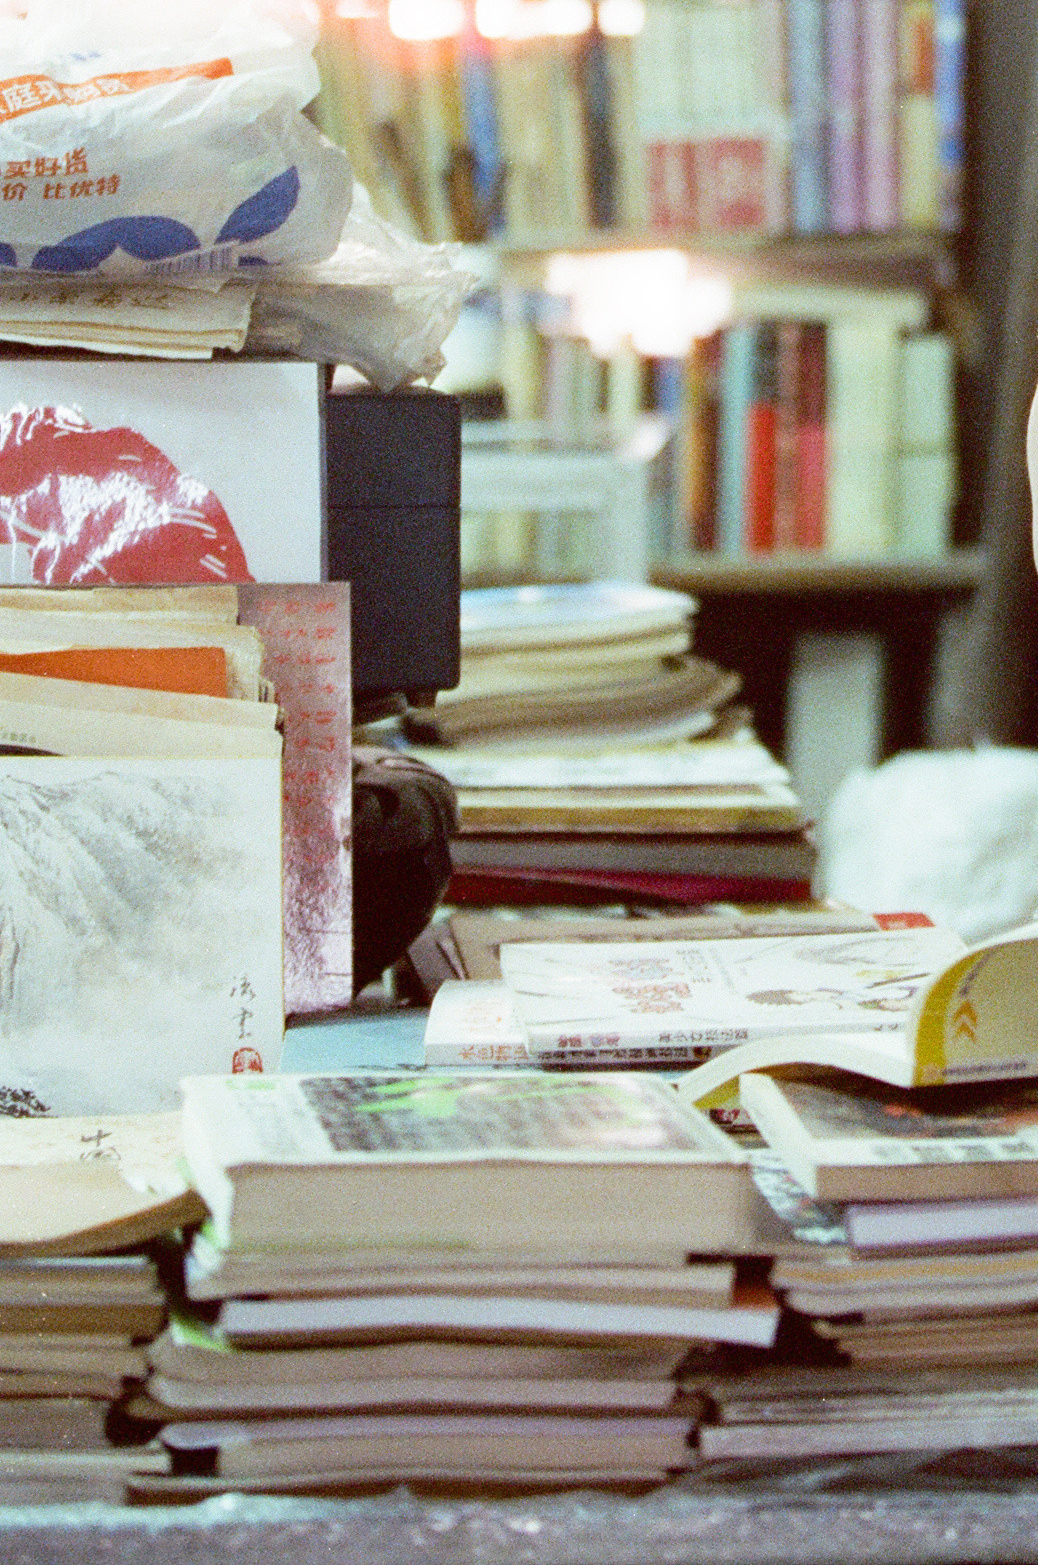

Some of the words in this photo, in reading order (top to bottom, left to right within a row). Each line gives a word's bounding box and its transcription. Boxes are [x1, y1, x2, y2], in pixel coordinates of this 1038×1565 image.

[0, 147, 89, 179] 买好货
[1, 182, 28, 202] 价
[43, 173, 121, 200] 比优特
